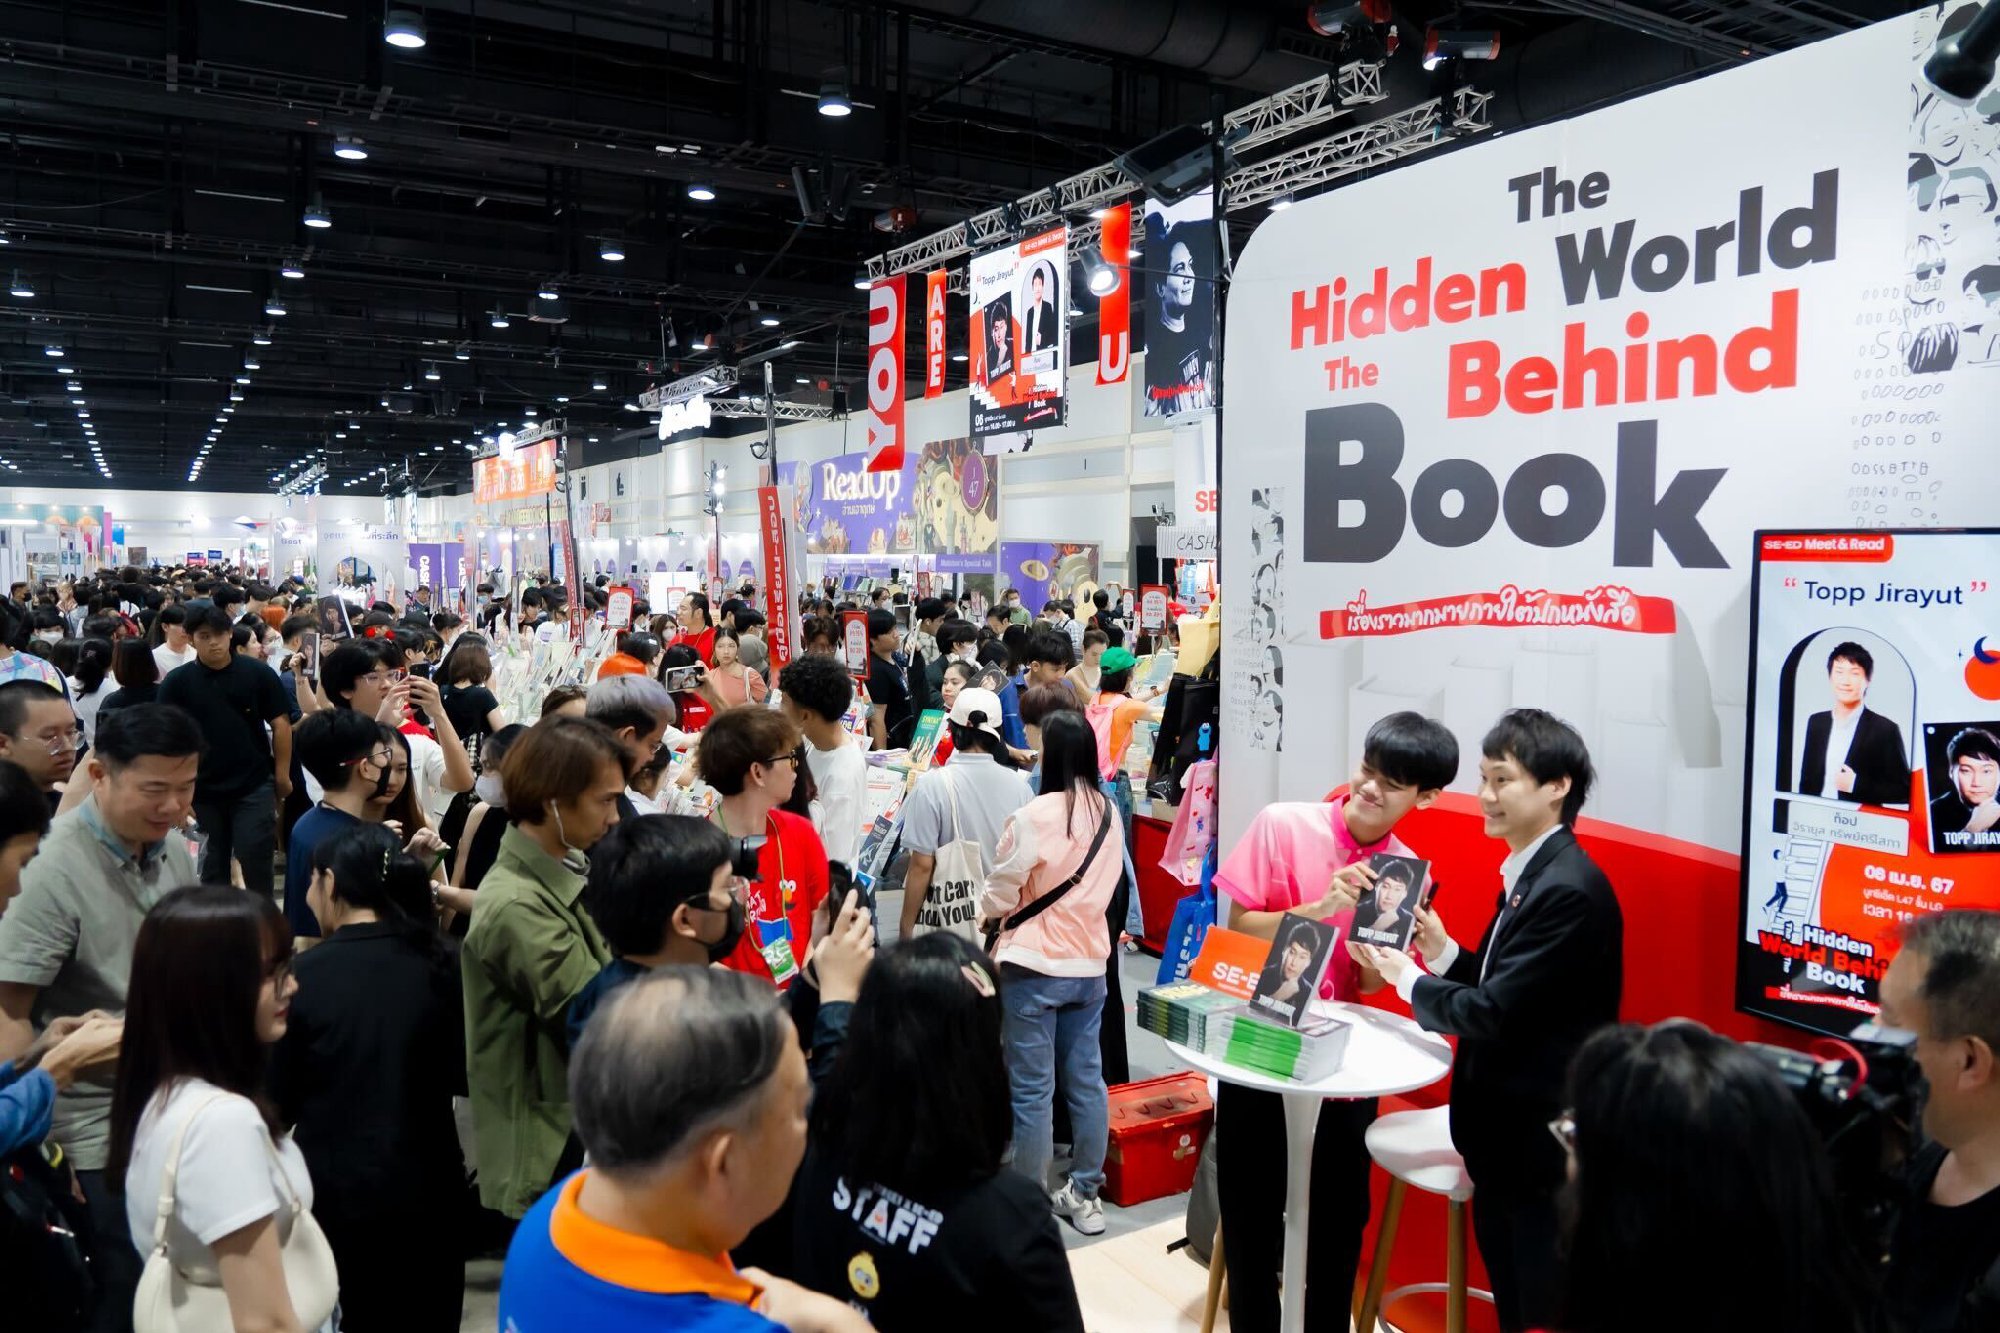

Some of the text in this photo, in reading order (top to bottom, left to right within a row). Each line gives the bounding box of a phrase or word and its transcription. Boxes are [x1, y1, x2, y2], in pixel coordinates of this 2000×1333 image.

[1508, 167, 1610, 223] The
[1291, 168, 1839, 350] Hidden World
[930, 283, 945, 388] ARE
[868, 285, 898, 458] YOU
[1324, 289, 1799, 419] The Behind
[1195, 490, 1217, 513] SE
[1303, 402, 1731, 570] Book
[1763, 538, 1885, 551] SE-ED Meet & Read
[1347, 585, 1637, 632] เรื่องราวมากมายภายใต้ปกหนังสือ
[1804, 581, 1963, 609] Topp Jirayut
[1943, 831, 1971, 845] TOPP
[1930, 876, 1955, 895] 67
[942, 900, 976, 927] You!
[1863, 903, 1914, 924] เวลา 16
[1758, 930, 1889, 980] World Behi
[1804, 924, 1873, 958] Hidden
[1212, 961, 1262, 990] SE-E
[1806, 960, 1866, 995] Book
[833, 1175, 939, 1256] STAFF
